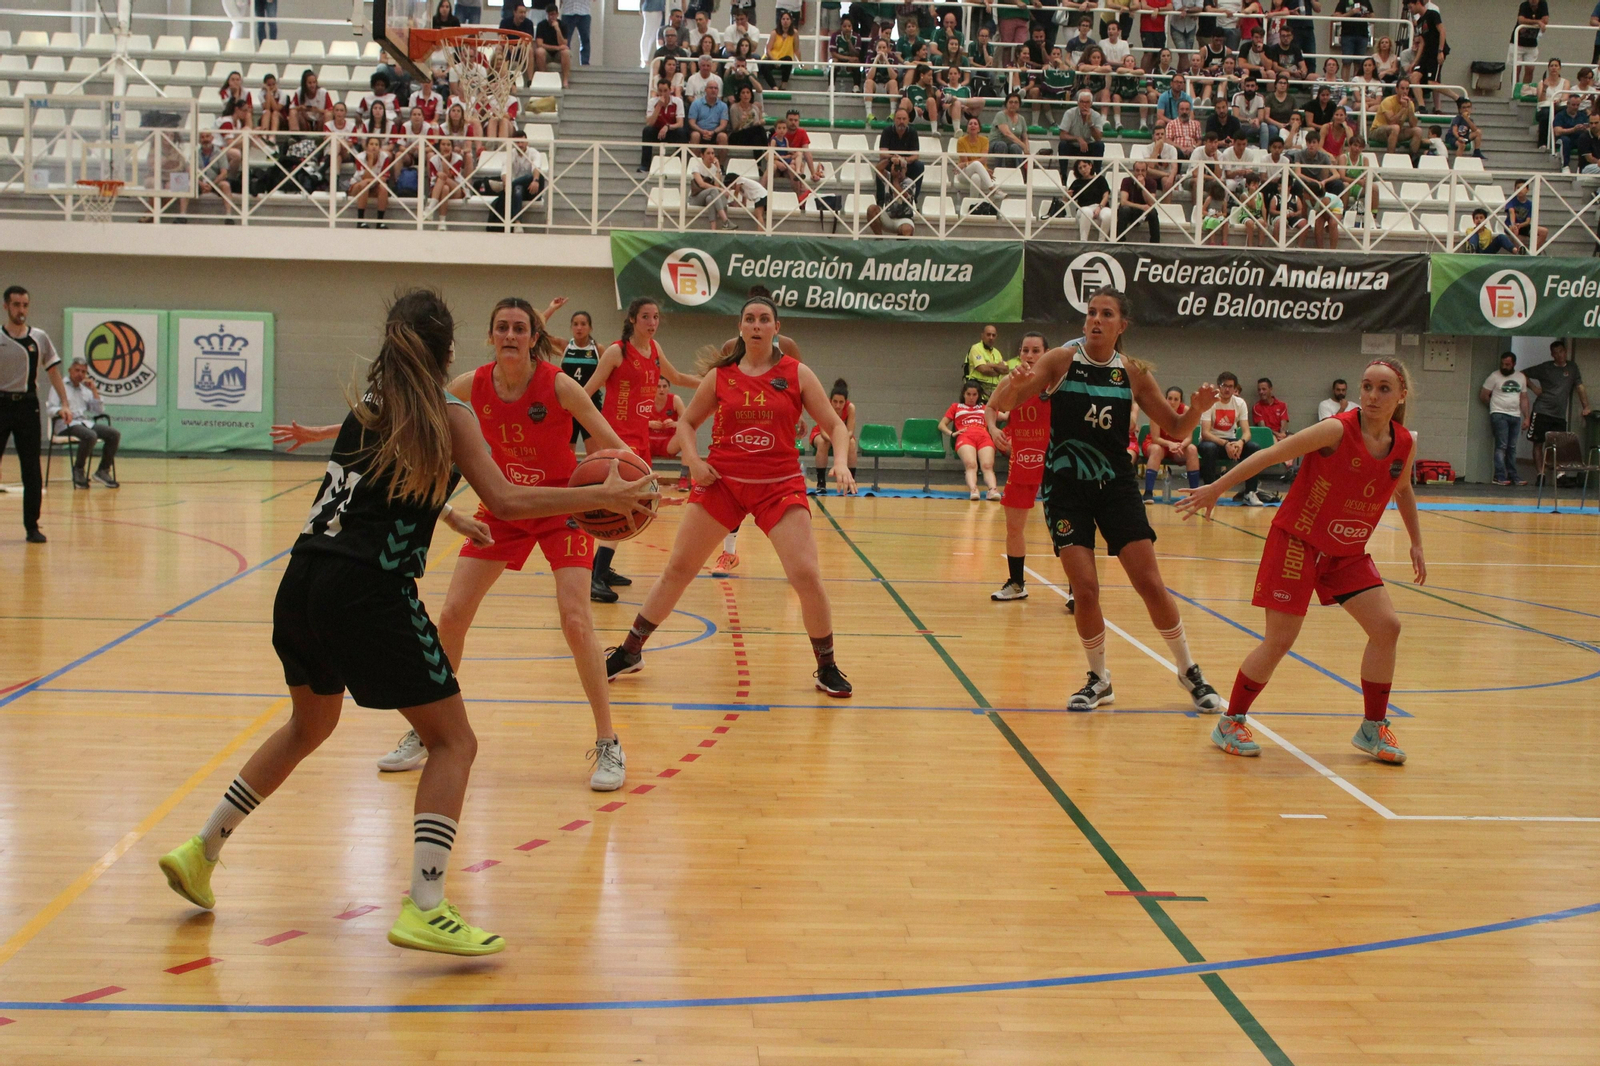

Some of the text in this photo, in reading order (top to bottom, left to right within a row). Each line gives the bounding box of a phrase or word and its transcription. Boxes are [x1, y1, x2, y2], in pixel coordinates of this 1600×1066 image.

[727, 253, 973, 282] Federación Andaluza
[1133, 258, 1389, 291] Federación Andaluza
[771, 285, 930, 312] de Baloncesto
[1177, 292, 1344, 321] de Baloncesto
[574, 367, 582, 381] 4
[616, 380, 630, 421] MARISTAS
[742, 390, 766, 407] 14
[735, 410, 774, 420] DESDE 1941
[1018, 405, 1037, 422] 10
[1084, 403, 1113, 430] 46
[498, 423, 525, 444] 13
[735, 434, 770, 447] Deza
[1018, 453, 1044, 463] Deza
[1363, 478, 1377, 498] 6
[1295, 475, 1332, 535] MARISTAS
[1344, 499, 1367, 511] DESDE
[1333, 523, 1368, 538] Deza
[563, 534, 588, 557] 13
